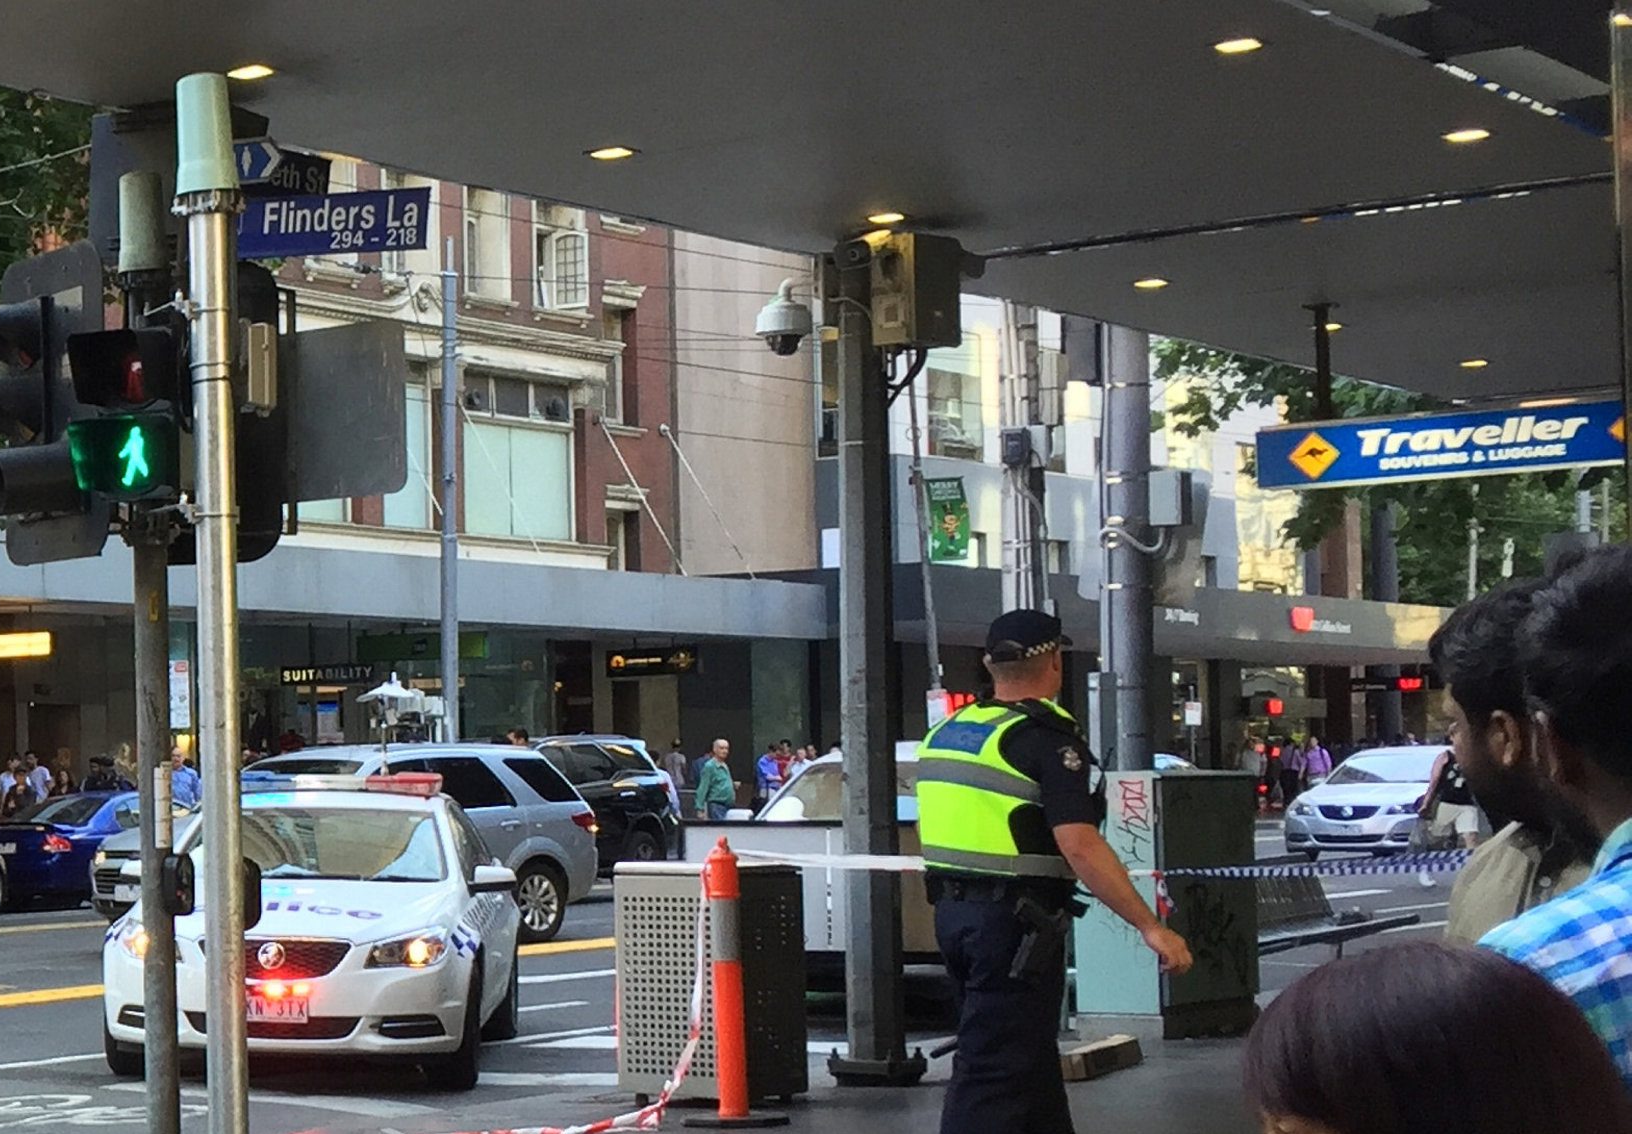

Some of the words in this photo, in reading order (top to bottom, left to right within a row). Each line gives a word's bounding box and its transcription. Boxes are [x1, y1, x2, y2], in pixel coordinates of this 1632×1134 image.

[262, 198, 376, 235] Flinders
[385, 194, 419, 228] La
[329, 230, 364, 250] 294
[386, 227, 417, 246] 218
[1357, 415, 1590, 457] Traveller
[1379, 450, 1469, 470] SOUVENIRS
[1473, 449, 1486, 463] &
[1489, 443, 1567, 461] LUGGAGE
[282, 665, 373, 683] SUITABILITY
